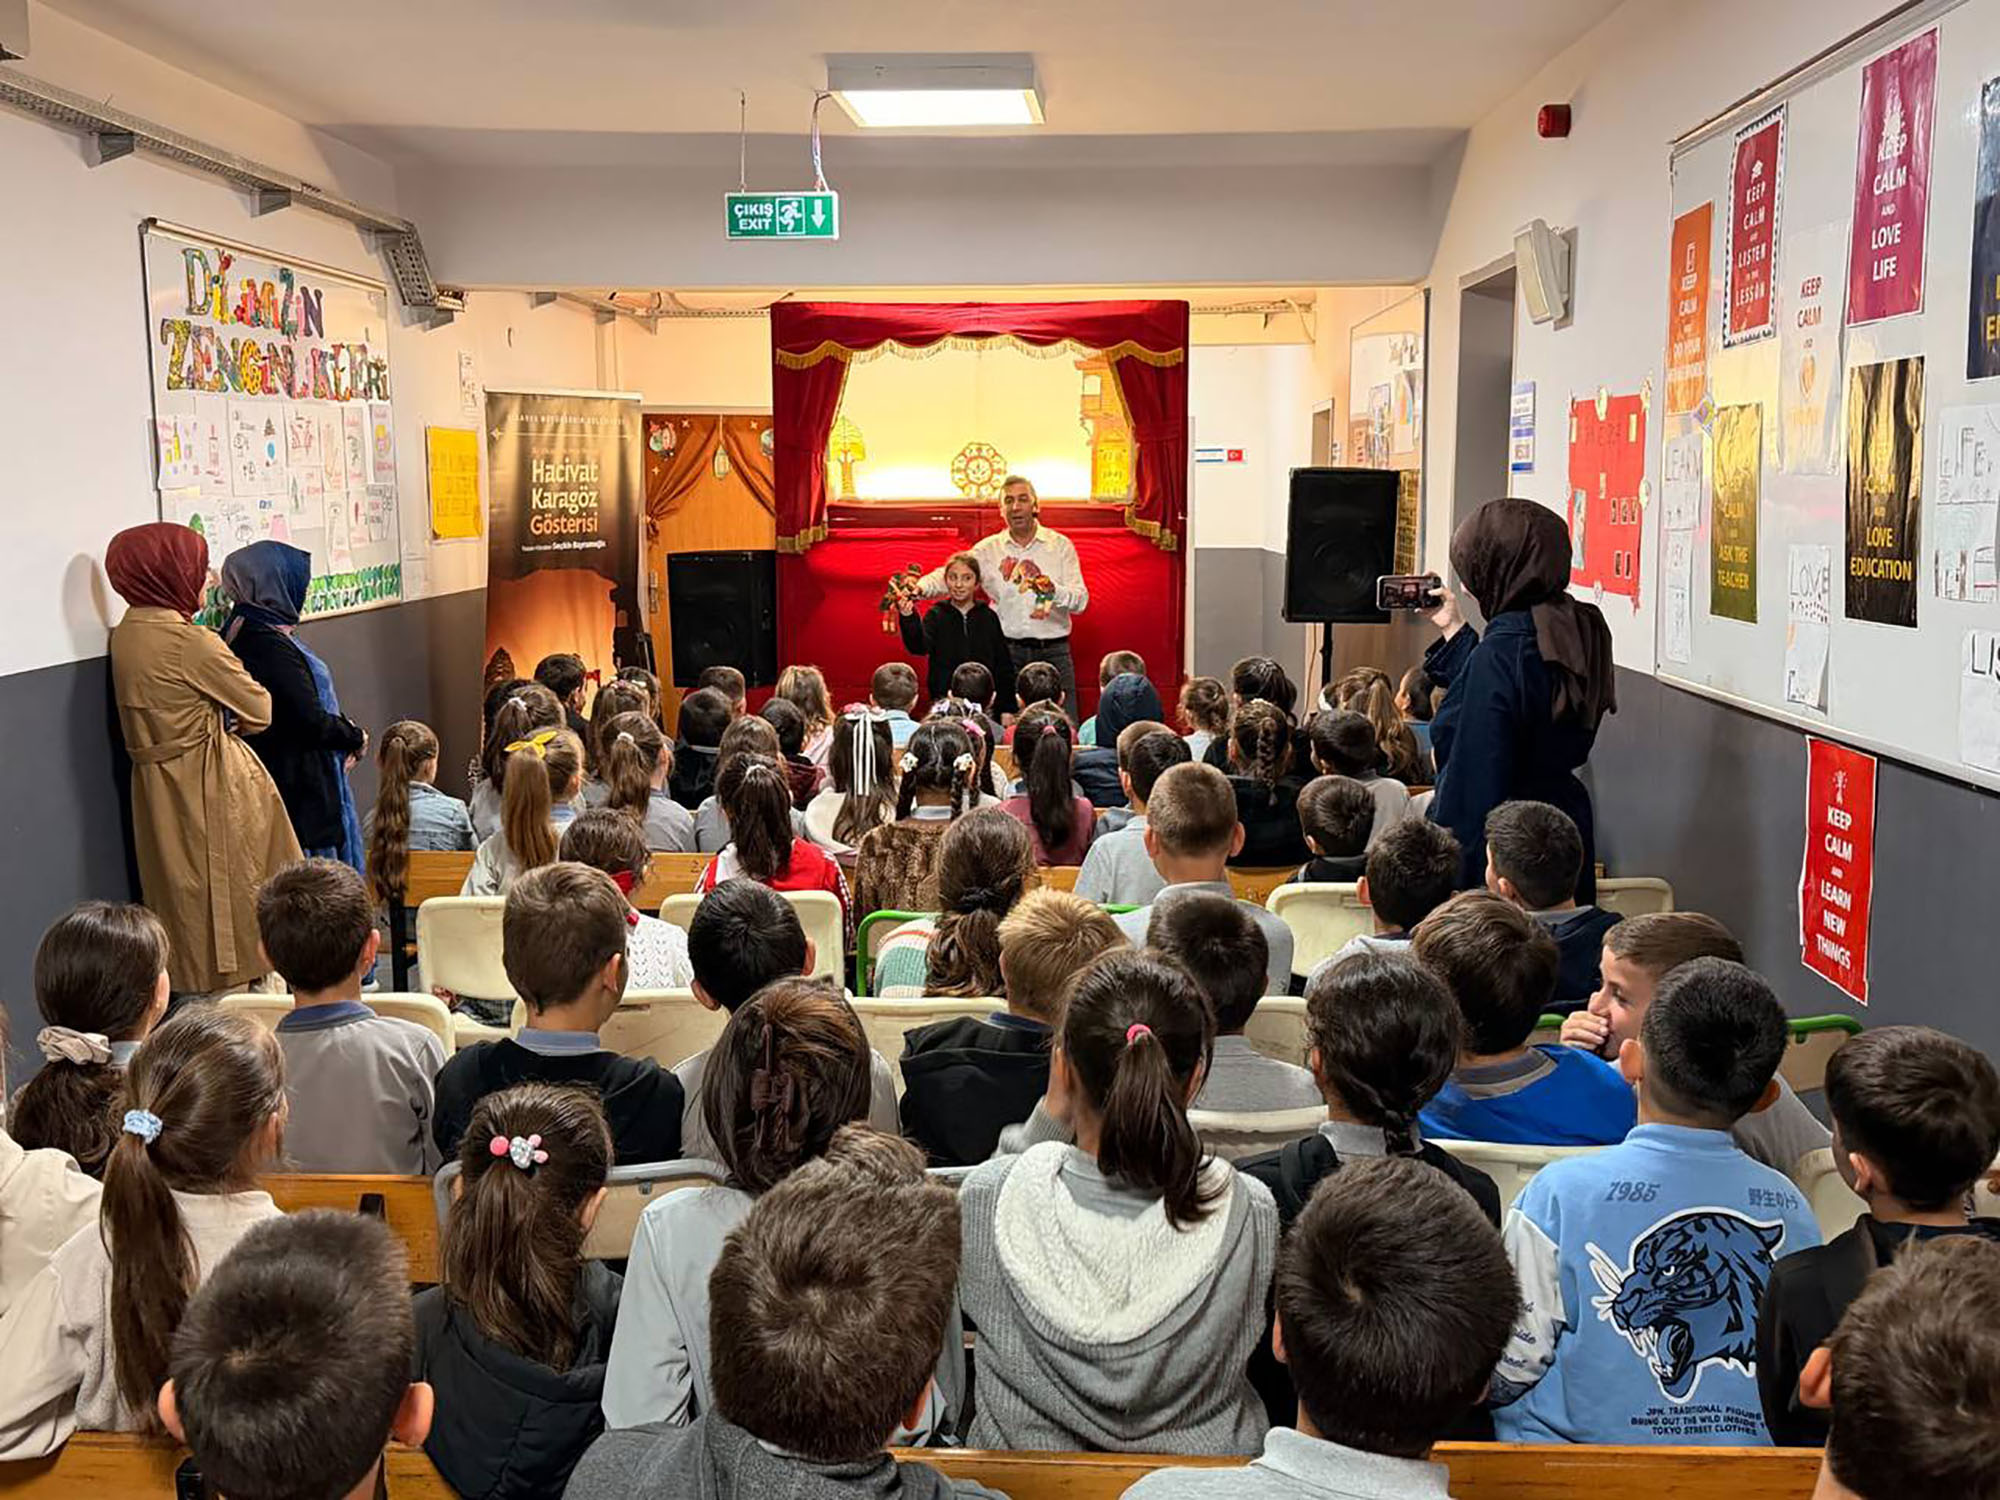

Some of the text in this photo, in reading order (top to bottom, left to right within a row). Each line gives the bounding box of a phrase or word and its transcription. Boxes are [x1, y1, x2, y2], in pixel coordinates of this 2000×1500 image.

[1873, 165, 1907, 196] CALM
[1746, 182, 1766, 205] KEEP
[734, 203, 773, 218] ÇIKIŞ
[1743, 206, 1766, 231] CALM
[1881, 203, 1896, 216] AND
[739, 218, 772, 230] EXIT
[1871, 222, 1902, 250] LOVE
[1738, 243, 1766, 268] LISTEN
[1873, 255, 1897, 282] LIFE
[1736, 281, 1765, 306] LESSON
[1800, 277, 1822, 298] KEEP
[1797, 306, 1822, 328] CALM
[531, 457, 599, 483] Hacivat
[531, 485, 599, 514] Karagöz
[530, 512, 599, 535] Gösterisi
[1866, 527, 1893, 547] LOVE
[1718, 570, 1750, 589] TEACHER
[1850, 557, 1912, 581] EDUCATION
[1827, 805, 1852, 831] KEEP
[1824, 834, 1852, 862] CALM
[1821, 880, 1851, 910] LEARN
[1823, 910, 1846, 937] NEW
[1816, 933, 1851, 969] THINGS
[1605, 1181, 1661, 1203] 1985
[1631, 1417, 1659, 1425] BRING
[1700, 1415, 1720, 1423] WILD
[1669, 1404, 1722, 1415] TRADITIONAL
[1652, 1426, 1682, 1435] TOKYO
[1684, 1425, 1712, 1434] STREET
